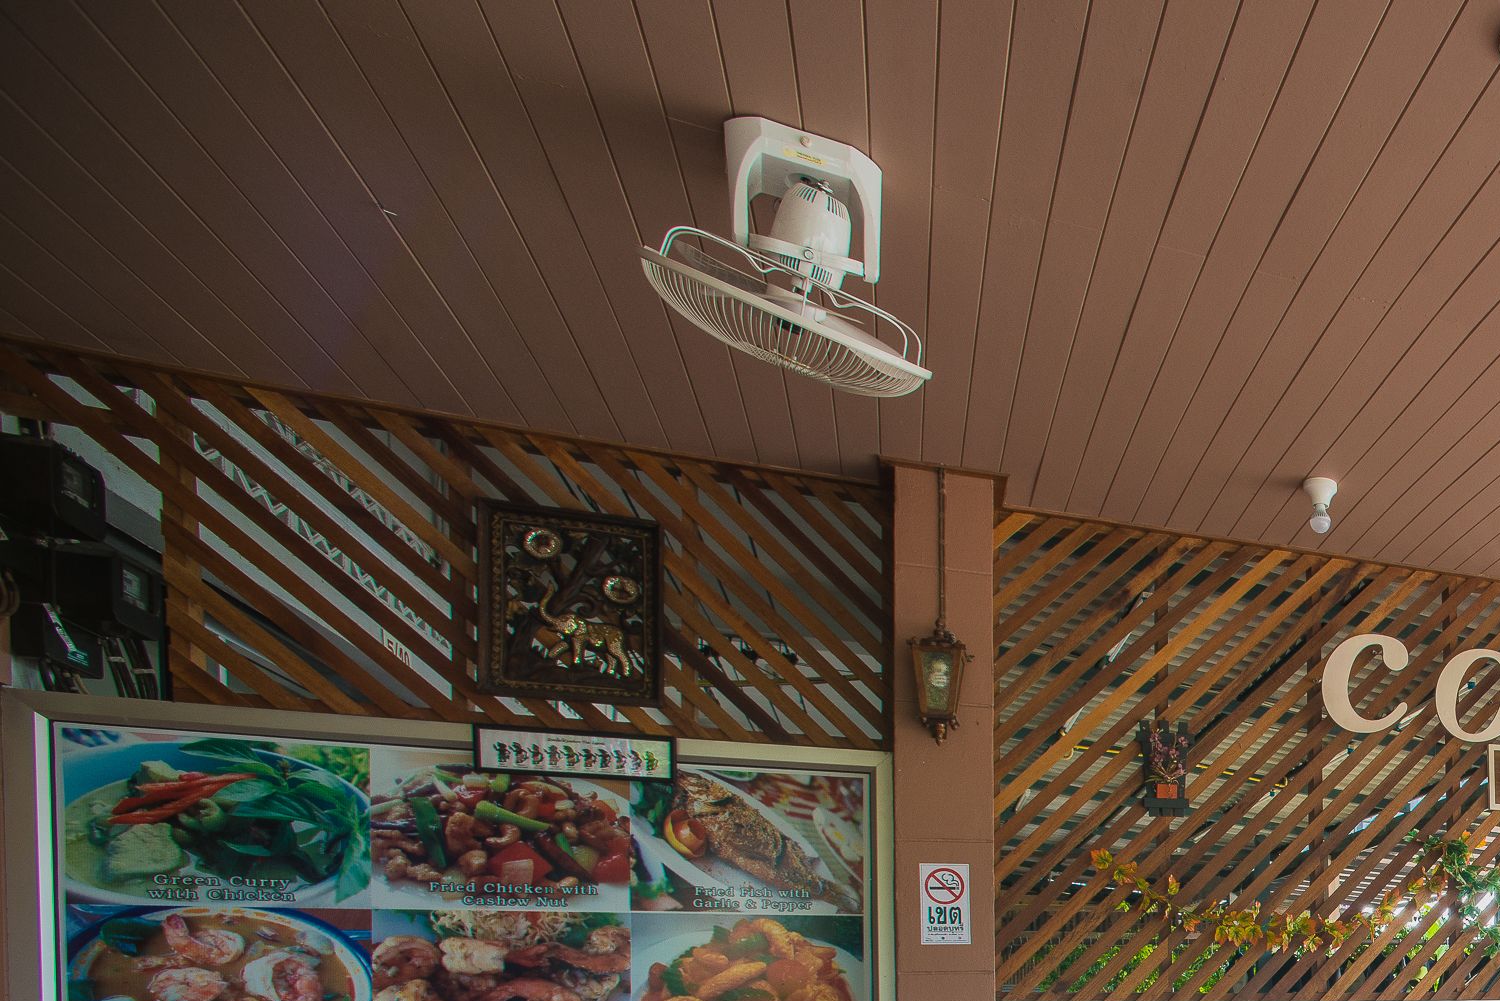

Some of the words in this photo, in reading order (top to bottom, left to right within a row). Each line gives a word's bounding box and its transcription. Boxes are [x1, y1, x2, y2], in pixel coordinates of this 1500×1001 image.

[153, 873, 221, 887] Green
[229, 875, 291, 890] Curry
[429, 881, 477, 893] Fried
[483, 882, 554, 894] Chicken
[561, 884, 599, 896] with
[148, 888, 200, 900] with
[207, 888, 297, 902] Chicken
[694, 885, 735, 898] Fried
[740, 886, 773, 898] Fish
[778, 887, 811, 899] with
[463, 895, 530, 906] Cashew
[536, 896, 569, 907] Nut
[692, 898, 740, 909] Garlic
[745, 899, 757, 910] &
[761, 899, 813, 912] Pepper
[928, 906, 962, 924] เขต
